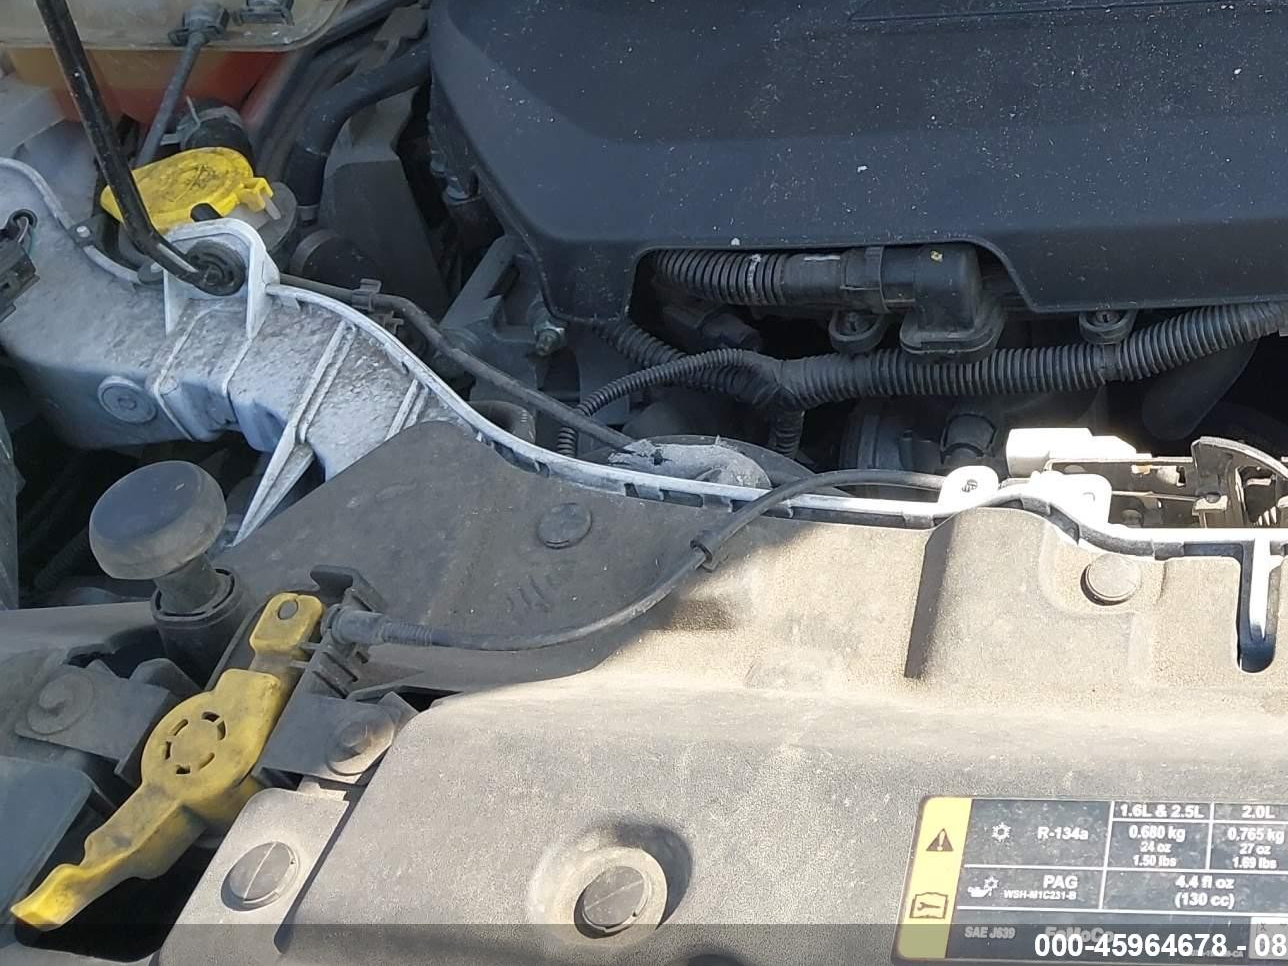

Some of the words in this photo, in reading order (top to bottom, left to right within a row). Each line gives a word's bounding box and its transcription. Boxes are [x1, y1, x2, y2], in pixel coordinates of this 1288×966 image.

[1120, 804, 1151, 817] 1.6L
[1155, 805, 1168, 817] &
[1171, 805, 1204, 818] 2.5L
[1241, 806, 1275, 819] 2.0L
[1037, 826, 1088, 840] R-134a
[1129, 825, 1165, 839] 0.680
[1168, 826, 1186, 842] kg
[1227, 827, 1264, 841] 0.765
[1267, 829, 1285, 844] kg
[1140, 841, 1155, 852] 24
[1157, 844, 1171, 853] oz
[1239, 843, 1254, 854] 27
[1256, 845, 1271, 855] oz
[1133, 855, 1156, 866] 1.50
[1159, 855, 1177, 867] lbs
[1232, 857, 1256, 868] 1.69
[1259, 857, 1277, 869] lbs
[1043, 874, 1079, 889] PAG
[1175, 875, 1198, 888] 4.4
[1201, 875, 1213, 888] fl
[1215, 878, 1235, 890] oz
[1174, 893, 1208, 908] (130
[1210, 894, 1235, 910] cc)
[965, 926, 989, 939] SAE
[990, 927, 1016, 939] J639
